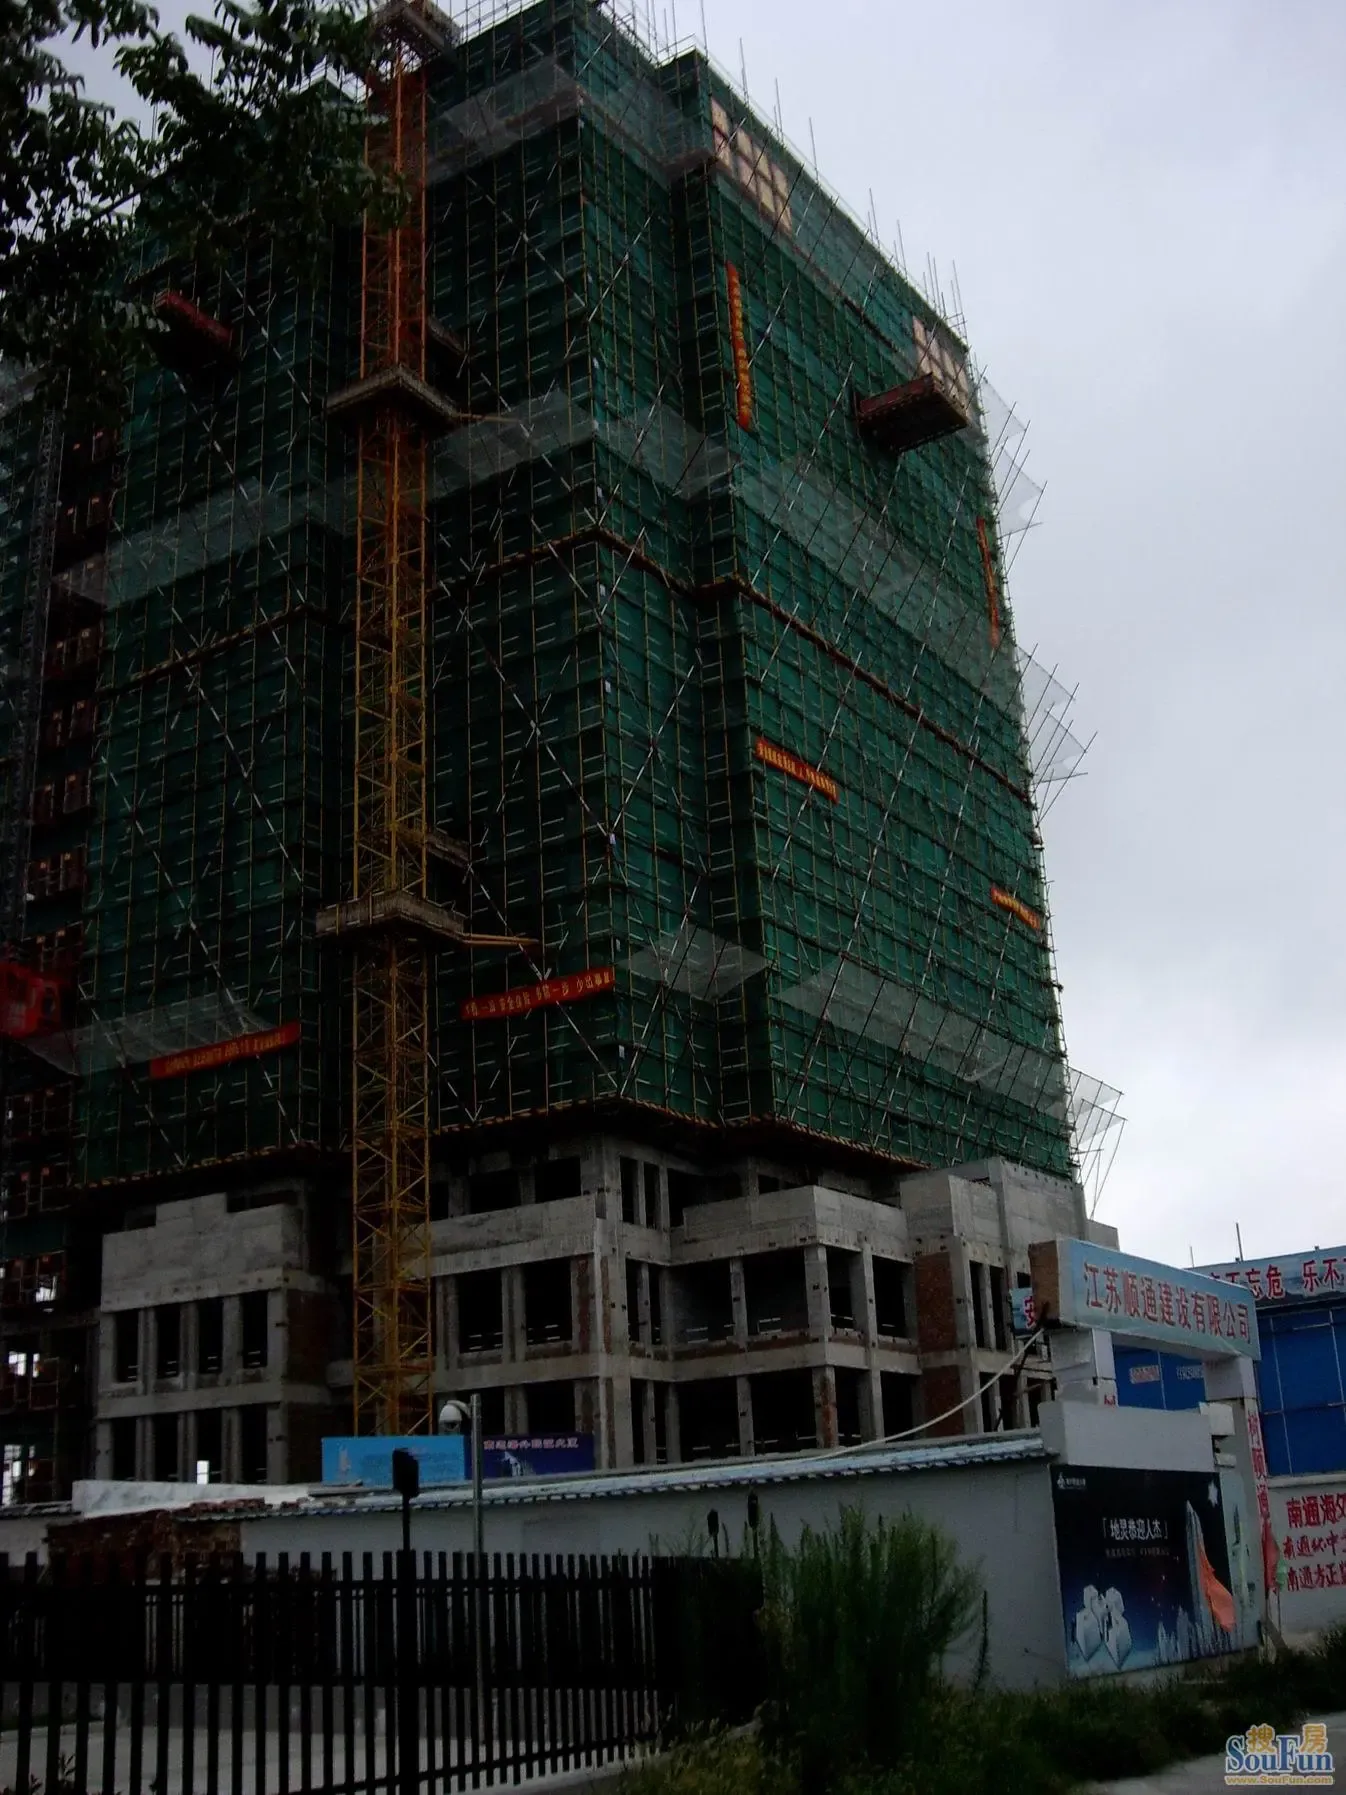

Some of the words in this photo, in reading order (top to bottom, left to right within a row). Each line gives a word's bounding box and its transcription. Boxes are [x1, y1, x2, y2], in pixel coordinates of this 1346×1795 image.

[1084, 1261, 1251, 1344] 江苏顺通建设有限公司
[1302, 1257, 1346, 1294] 乐不
